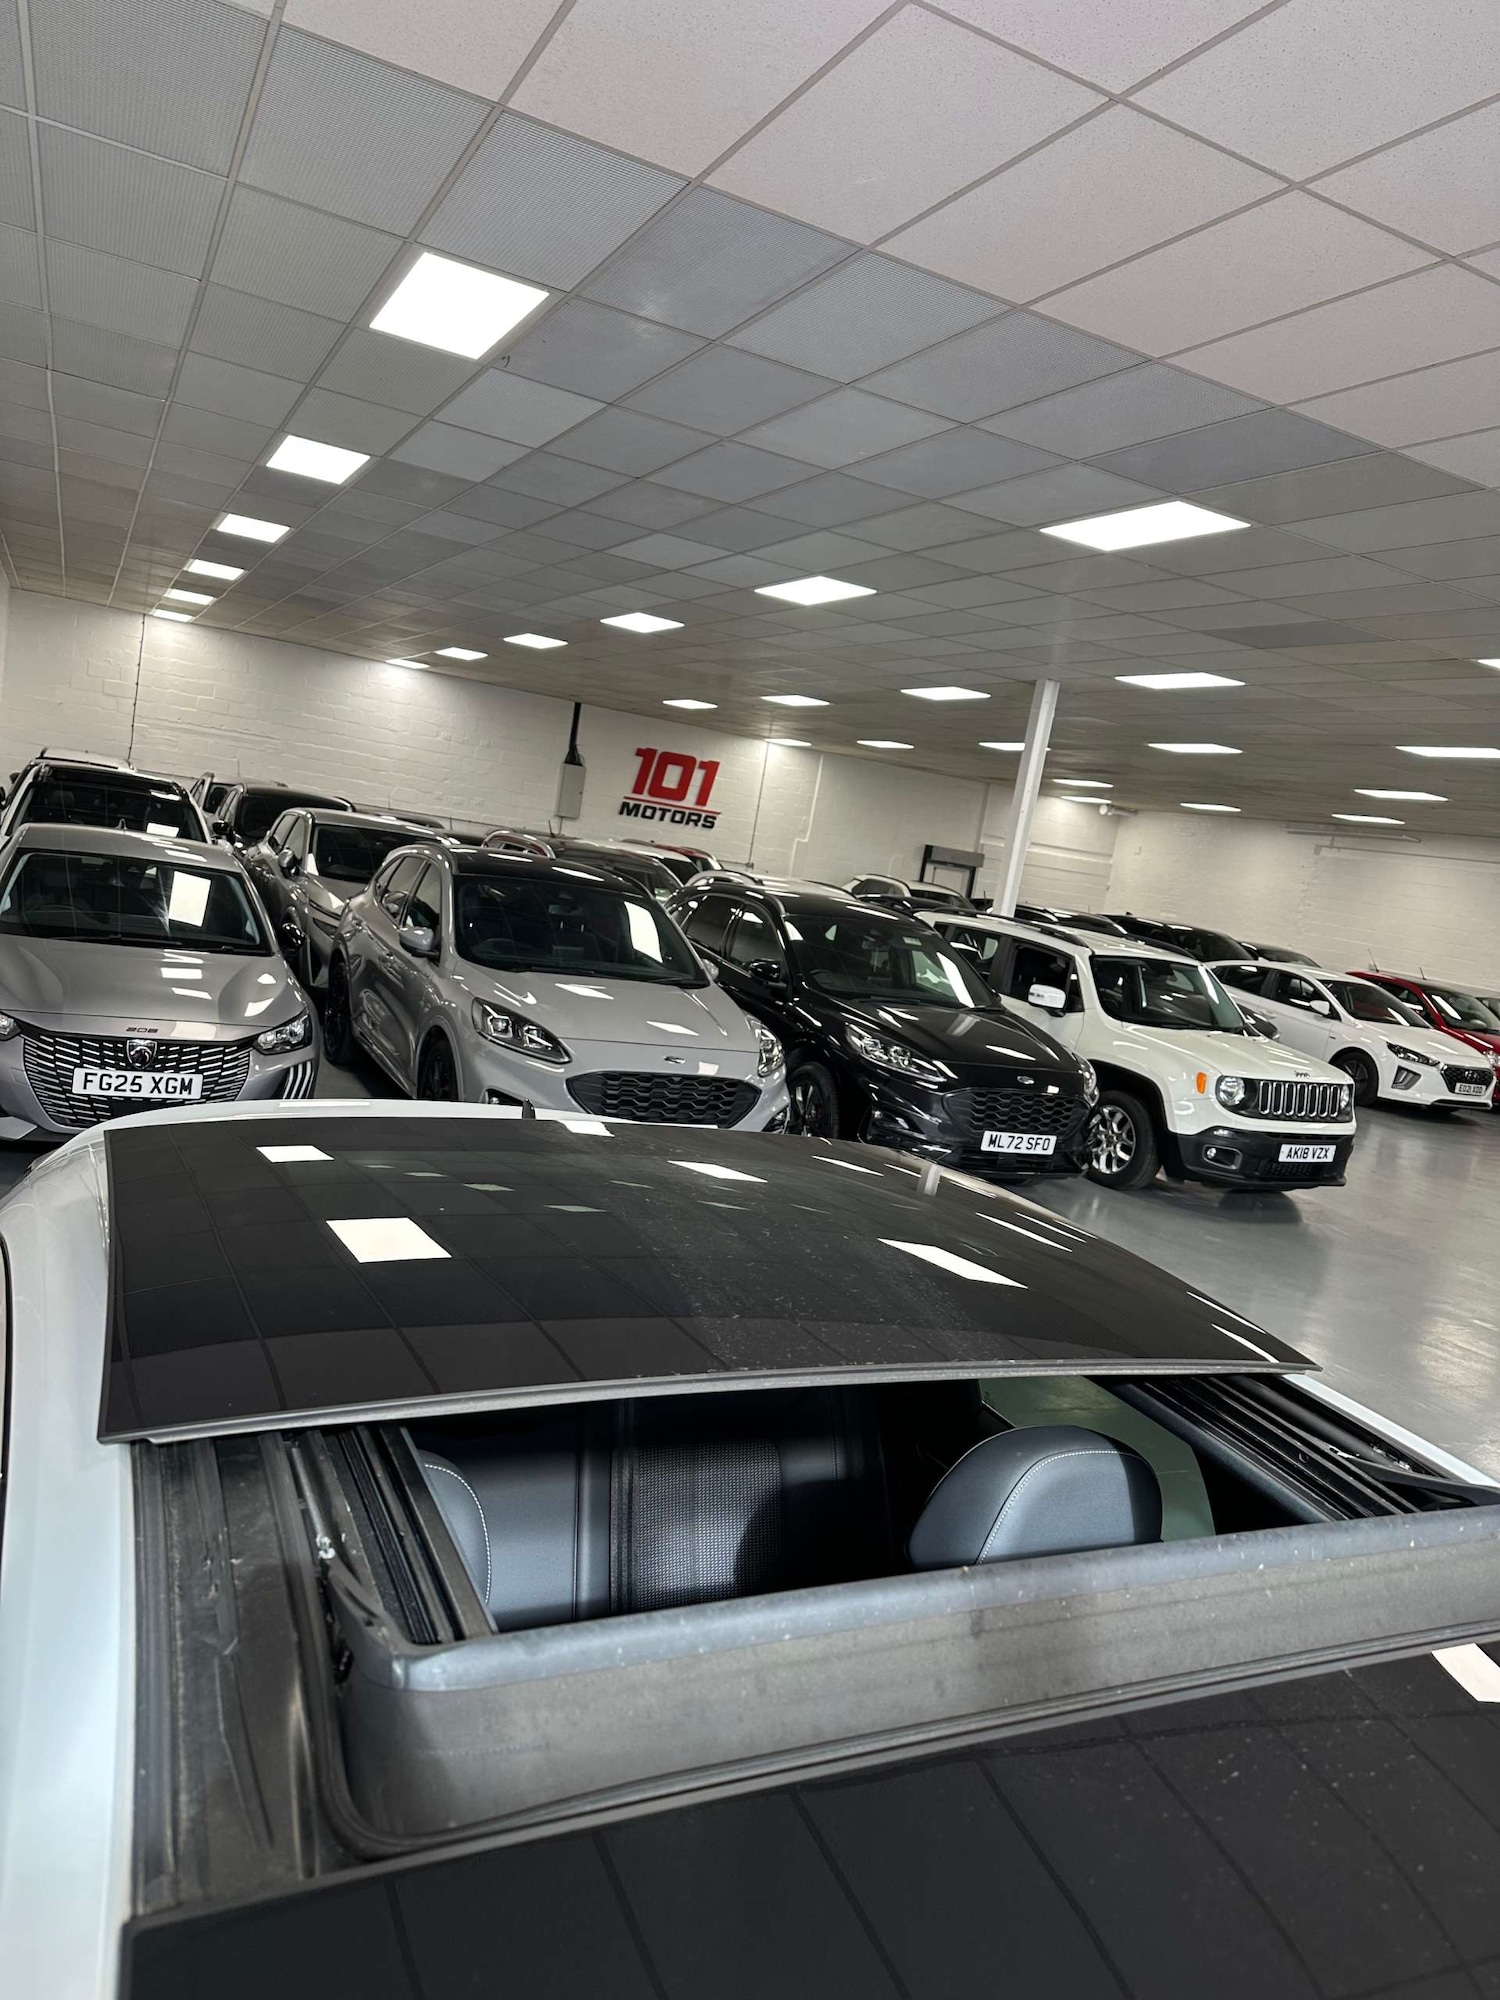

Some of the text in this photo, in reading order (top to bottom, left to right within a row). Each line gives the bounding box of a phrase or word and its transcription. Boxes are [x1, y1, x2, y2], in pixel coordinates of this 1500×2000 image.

[632, 747, 720, 807] 101
[618, 801, 718, 829] MOTORS
[83, 1072, 193, 1095] FG25 XGM
[1026, 1137, 1051, 1151] SFO
[1286, 1147, 1330, 1159] AK18 VZX
